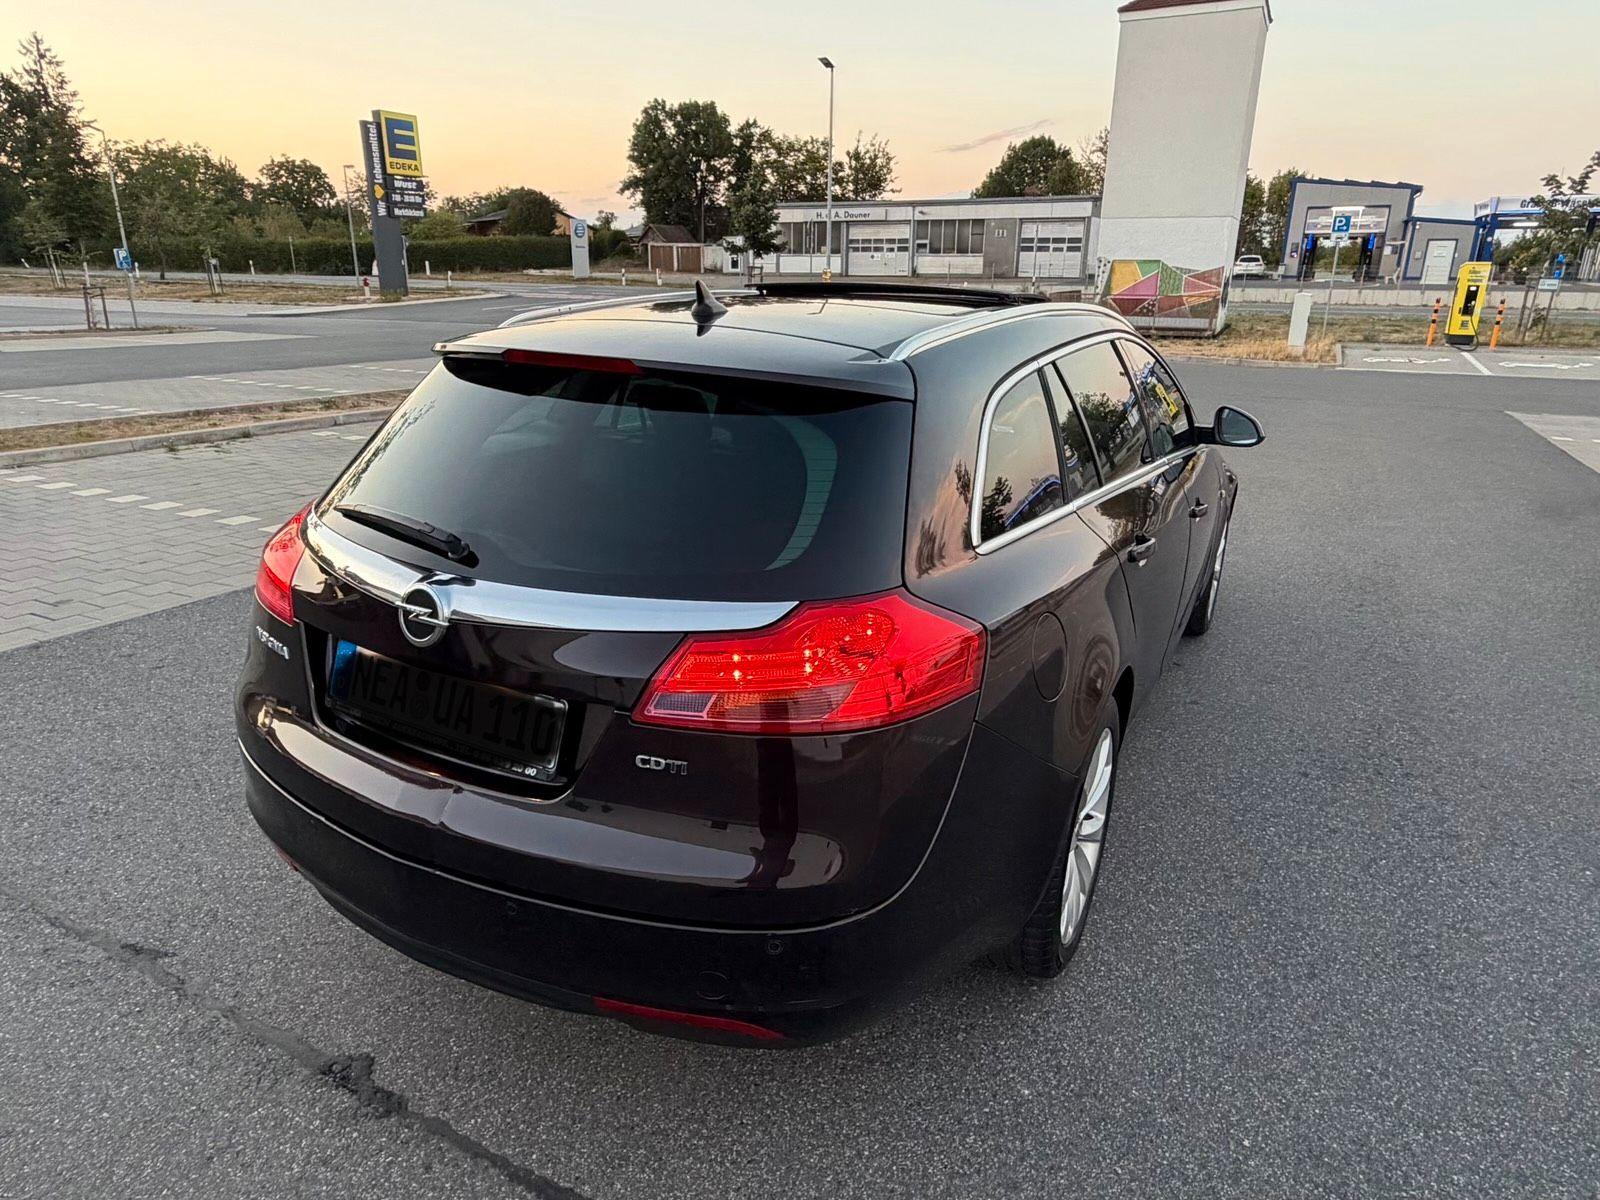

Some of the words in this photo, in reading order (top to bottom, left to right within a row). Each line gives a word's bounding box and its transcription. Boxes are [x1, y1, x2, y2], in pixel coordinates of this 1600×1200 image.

[389, 161, 419, 171] EDEKA
[376, 201, 387, 216] Wir
[844, 210, 870, 219] Dauner
[1334, 217, 1346, 231] P
[118, 250, 127, 261] P
[351, 652, 409, 714] NEA
[433, 677, 475, 735] UA
[482, 694, 557, 755] 110
[635, 755, 688, 776] CDTI
